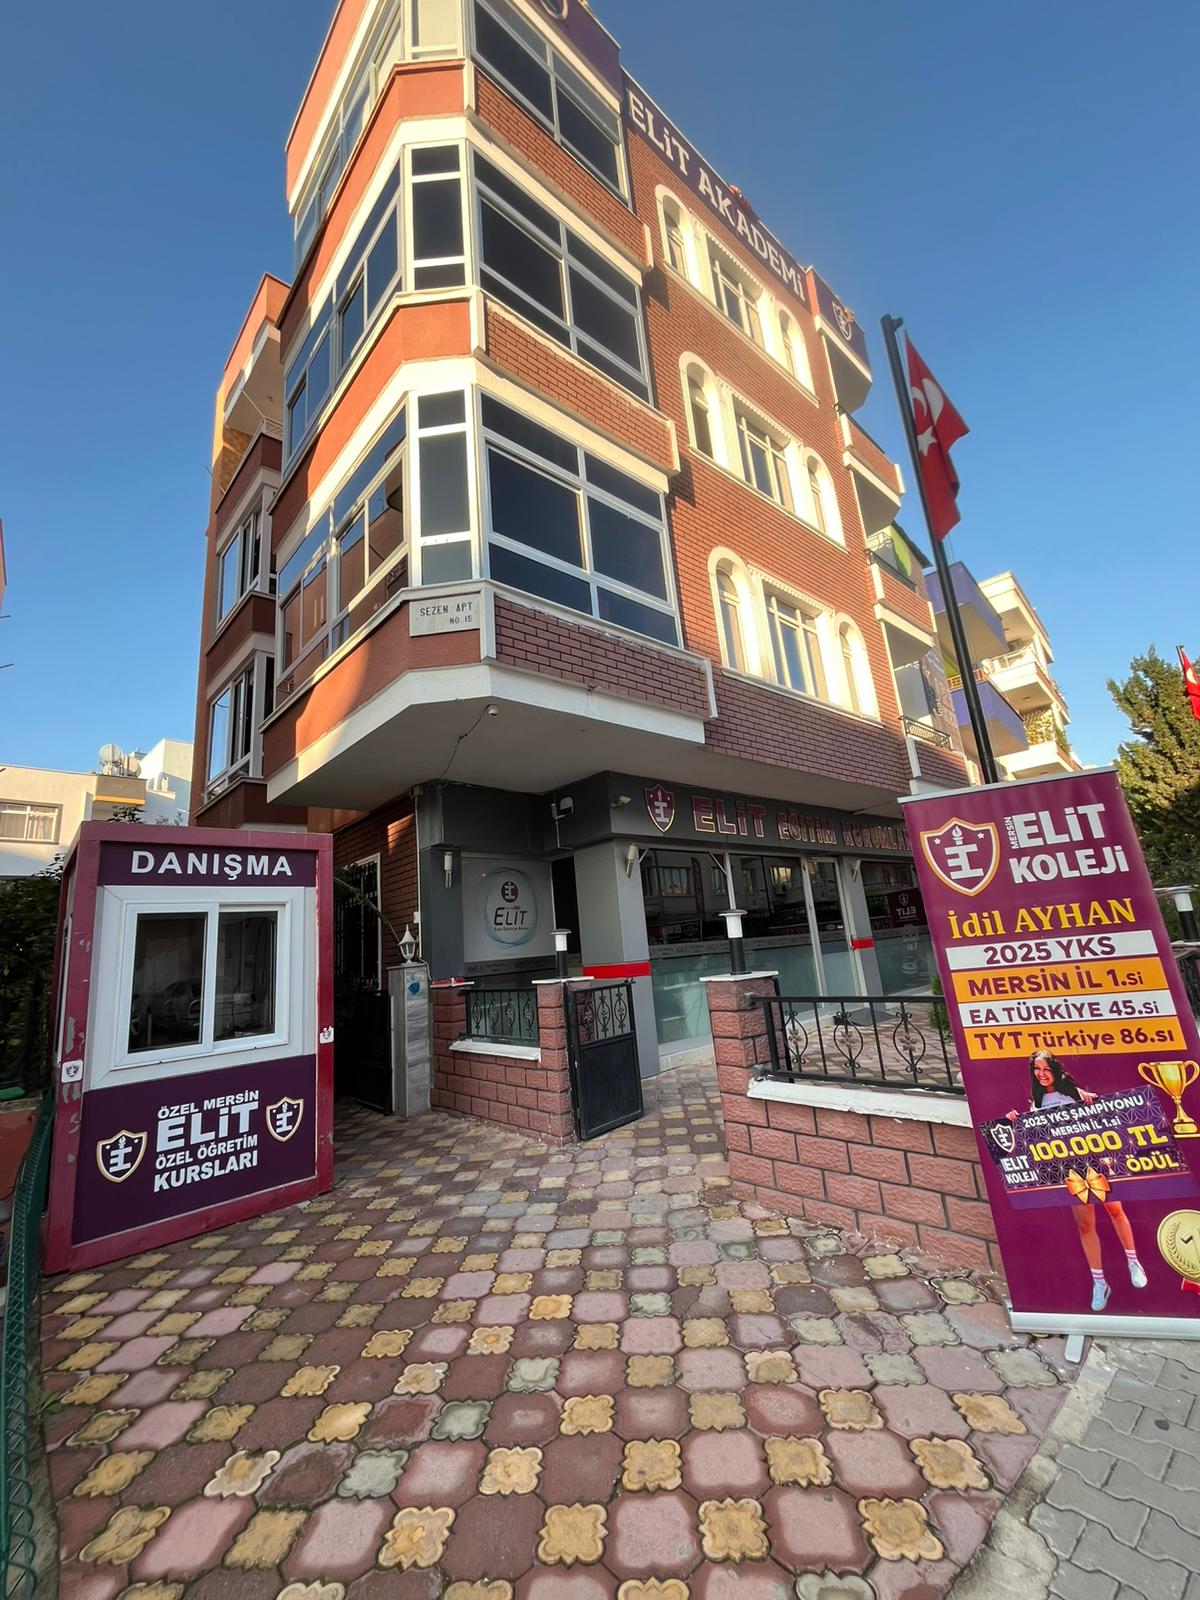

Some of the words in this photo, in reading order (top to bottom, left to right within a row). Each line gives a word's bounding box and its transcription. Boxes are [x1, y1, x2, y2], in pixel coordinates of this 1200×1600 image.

[420, 604, 449, 616] SEZEN
[455, 602, 473, 612] APT
[691, 795, 766, 837] ELiT
[1012, 803, 1105, 848] ELiT
[131, 850, 292, 881] DANIŞMA
[1008, 845, 1130, 884] KOLEJi
[948, 909, 1006, 940] İdil
[1014, 897, 1136, 934] AYHAN
[983, 942, 1051, 966] 2025
[1056, 936, 1116, 959] YKS
[968, 968, 1070, 997] MERSİN
[1074, 965, 1102, 989] İL
[969, 1007, 1000, 1025] EA
[1002, 999, 1104, 1024] TÜRKİYE
[974, 1031, 1023, 1051] TYT
[1028, 1029, 1115, 1050] Türkiye
[157, 1105, 199, 1119] ÖZEL
[203, 1089, 259, 1111] MERSİN
[1022, 1117, 1048, 1129] 2025
[1047, 1110, 1070, 1124] YKS
[1070, 1094, 1144, 1120] ŞAMPİYONU
[156, 1101, 259, 1153] ELiT
[1029, 1130, 1123, 1162] 100.000
[1127, 1124, 1169, 1147] TL
[1050, 1121, 1089, 1137] MERSİN
[1090, 1118, 1102, 1130] İL
[155, 1153, 194, 1170] ÖZEL
[197, 1134, 258, 1160] ÖĞRETİM
[1126, 1150, 1179, 1172] ÖDÜL
[153, 1150, 258, 1193] KURSLARI
